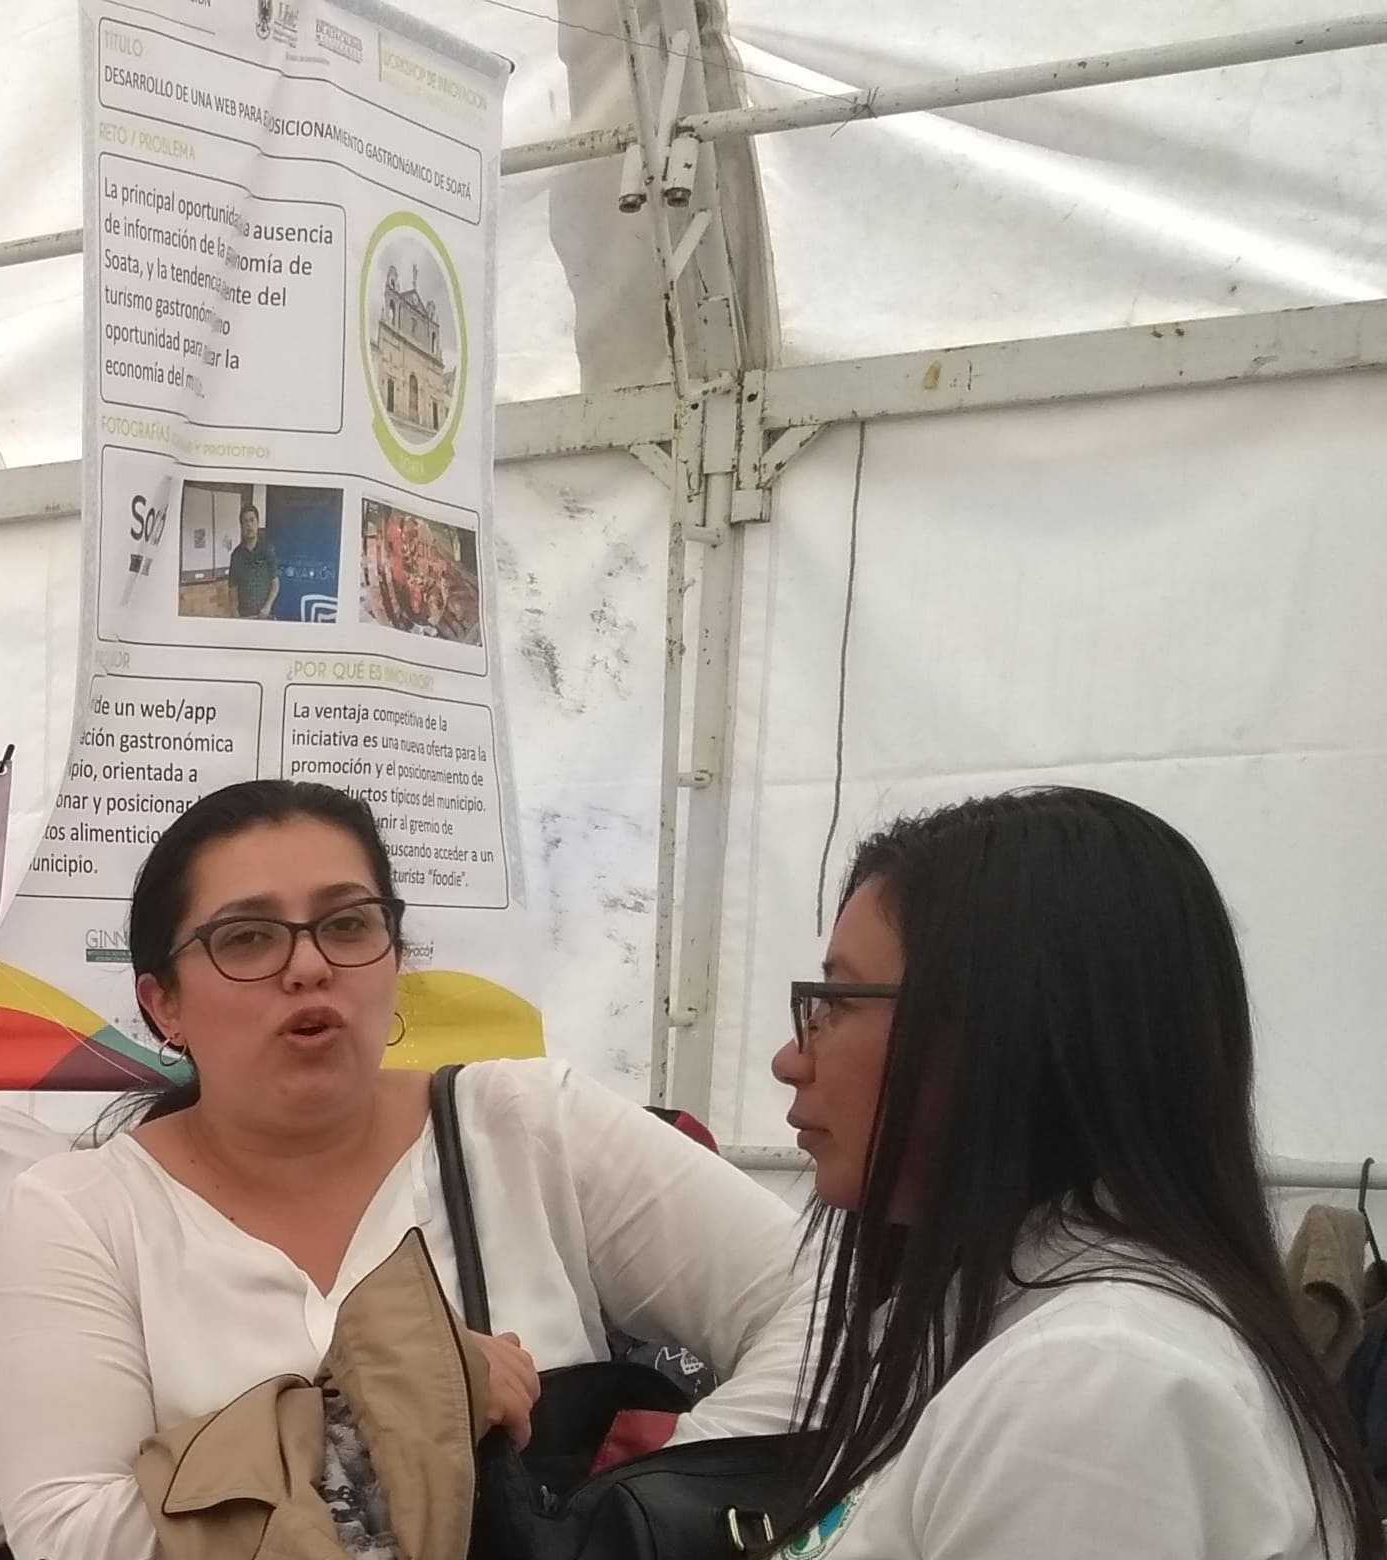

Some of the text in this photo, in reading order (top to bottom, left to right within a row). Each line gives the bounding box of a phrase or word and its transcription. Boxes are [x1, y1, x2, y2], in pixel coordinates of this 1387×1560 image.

[105, 65, 262, 125] DESARROLLO DE UNA WEB PARA
[105, 177, 175, 213] La principal
[434, 171, 444, 189] DE
[446, 177, 471, 200] SOATÁ
[104, 212, 225, 258] de información de la
[253, 224, 332, 244] ausencia
[105, 285, 153, 315] turismo
[105, 324, 181, 357] oportunidad
[286, 660, 388, 681] ¿POR QUÉ ES
[95, 695, 216, 724] de un web/app
[293, 702, 447, 731] La ventaja competitiva de la
[119, 732, 233, 752] gastronómica
[102, 761, 197, 782] orientada a
[106, 793, 193, 816] posicionar
